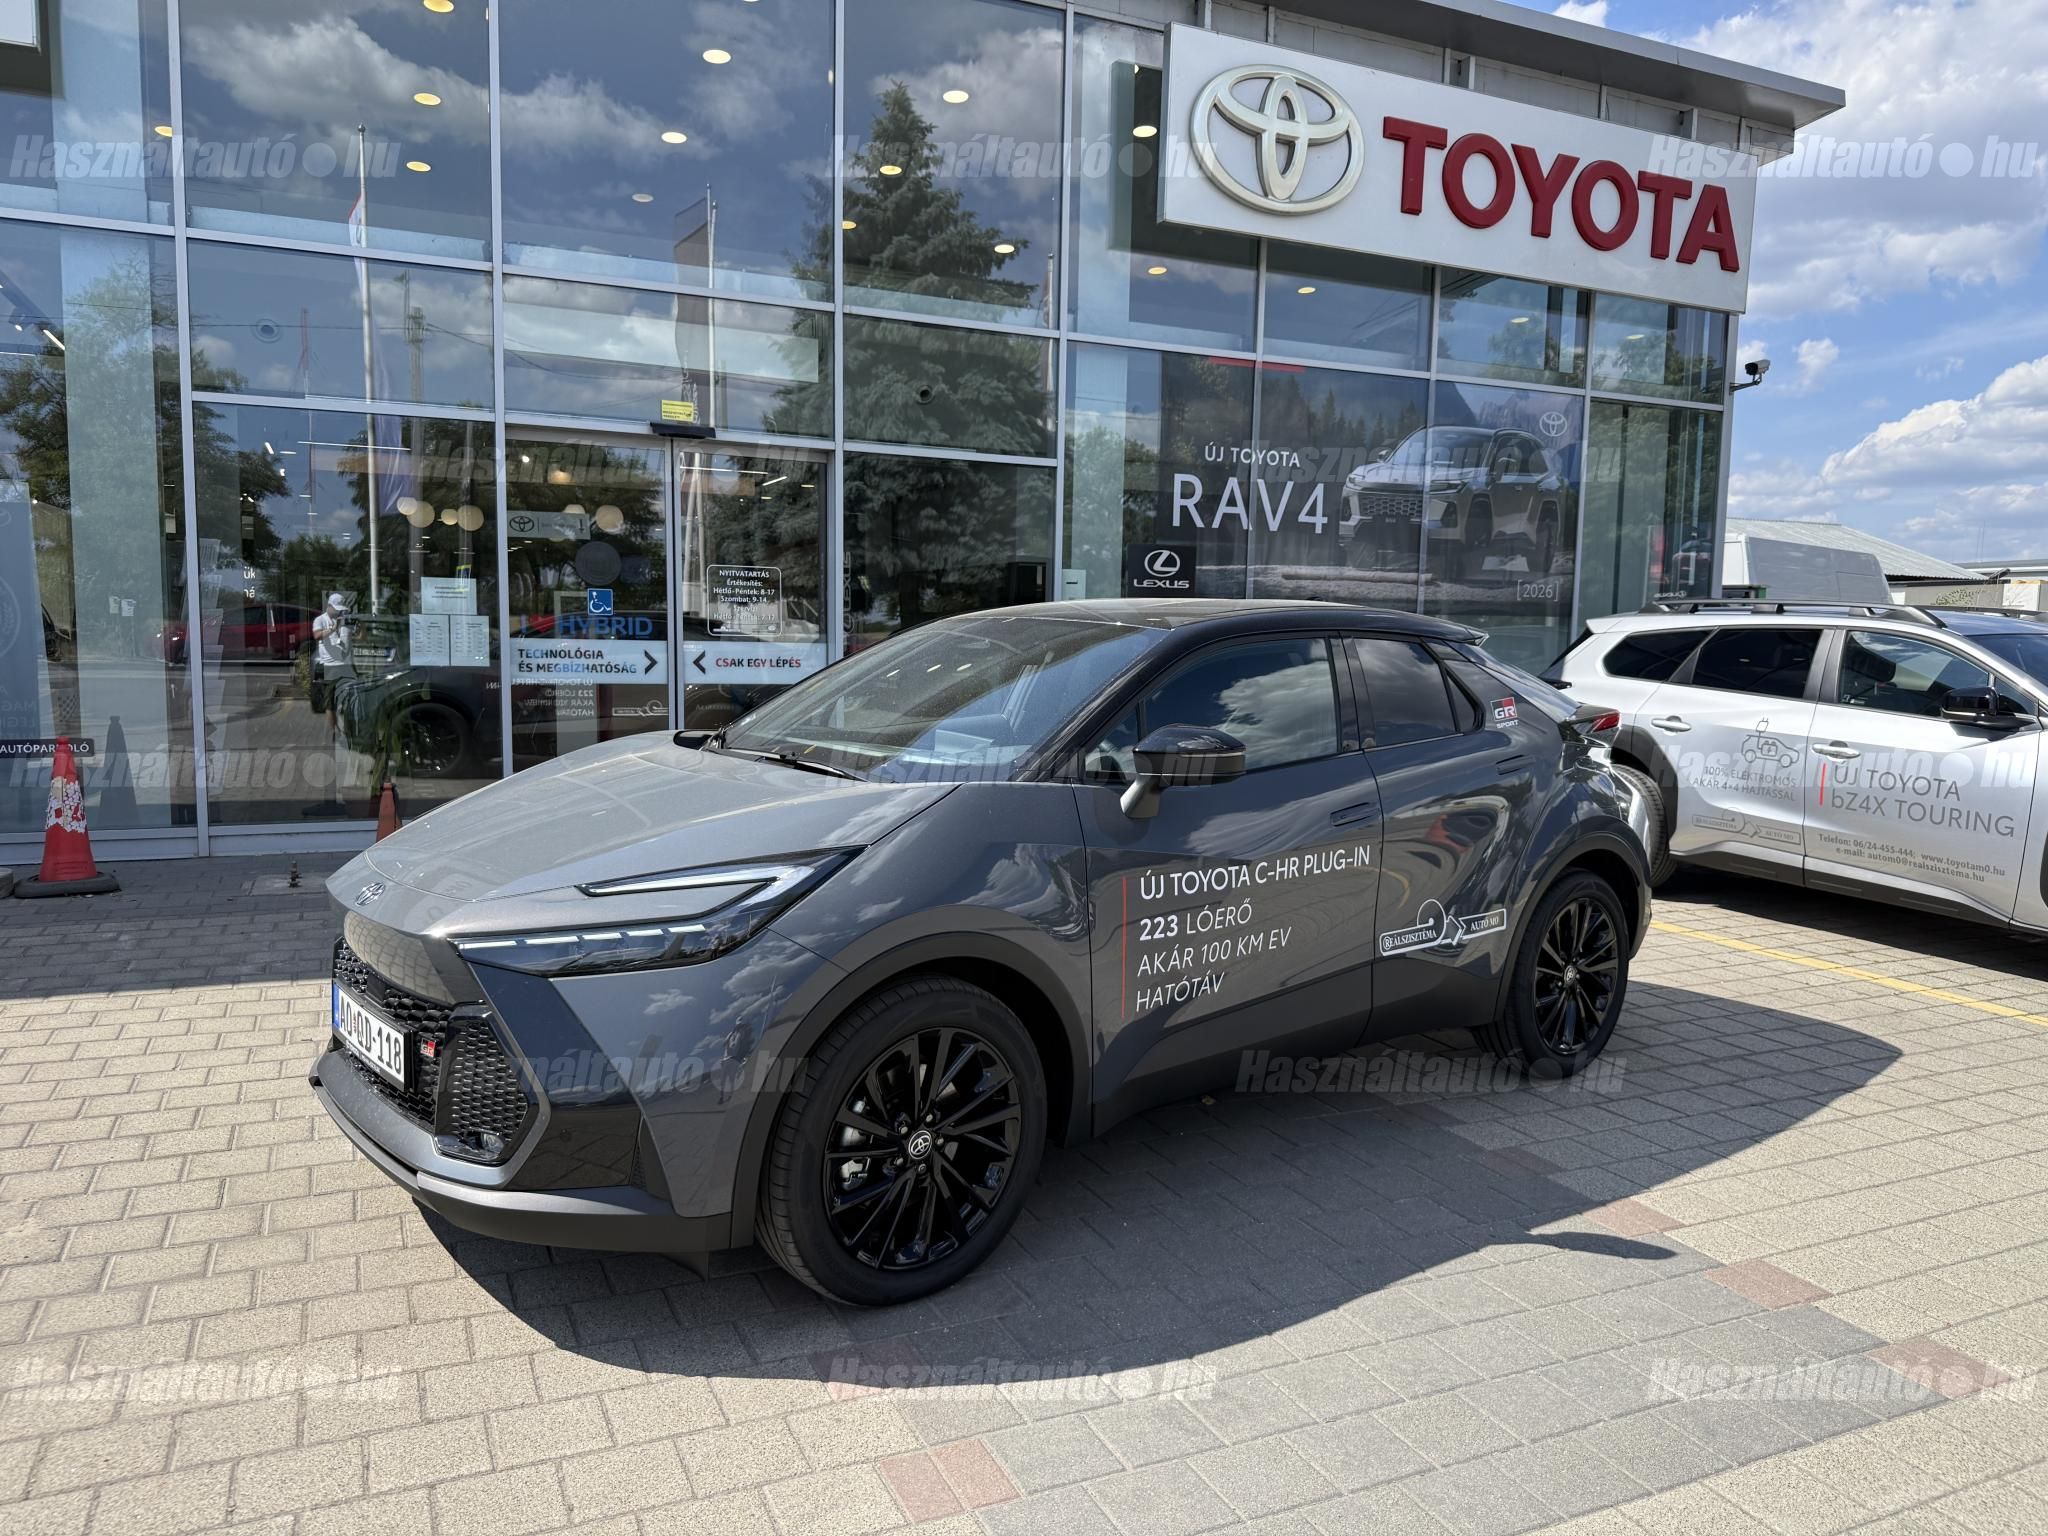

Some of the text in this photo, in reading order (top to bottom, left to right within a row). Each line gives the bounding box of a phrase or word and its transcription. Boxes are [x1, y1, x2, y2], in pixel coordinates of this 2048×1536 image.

[1383, 116, 1739, 272] TOYOTA
[1204, 441, 1300, 468] ÚJ TOYOTA
[1172, 473, 1328, 534] RAV4
[719, 570, 770, 578] NYITVATARTÁS
[726, 578, 763, 586] Értékesítés:
[1134, 578, 1190, 589] LEXUS
[720, 595, 751, 603] Szombat:
[558, 615, 654, 636] HYBRID
[518, 647, 604, 659] TECHNOLÓGIA
[518, 661, 638, 674] ÉS MEGBÍZHATÓSÁG
[715, 656, 801, 668] CSAK EGY LÉPÉS
[1494, 706, 1515, 719] GR
[1496, 720, 1519, 729] SPORT
[0, 741, 90, 754] AUTÓPARLÓ
[1704, 766, 1729, 777] 100%
[1834, 761, 1961, 801] ÚJ TOYOTA
[1741, 783, 1794, 801] HAJTÁSSAL
[1832, 788, 2015, 838] bZ4X TOURING
[1819, 833, 1852, 847] Telefon:
[1836, 846, 1866, 859] e-mail:
[1140, 845, 1370, 900] ÚJ TOYOTA C-HR PLUG-IN
[1139, 898, 1252, 941] 223 LÓERŐ
[1470, 917, 1489, 932] AUTÓ
[1137, 926, 1292, 977] AKÁR 100 KM EV
[1136, 970, 1225, 1012] HATÓTÁV
